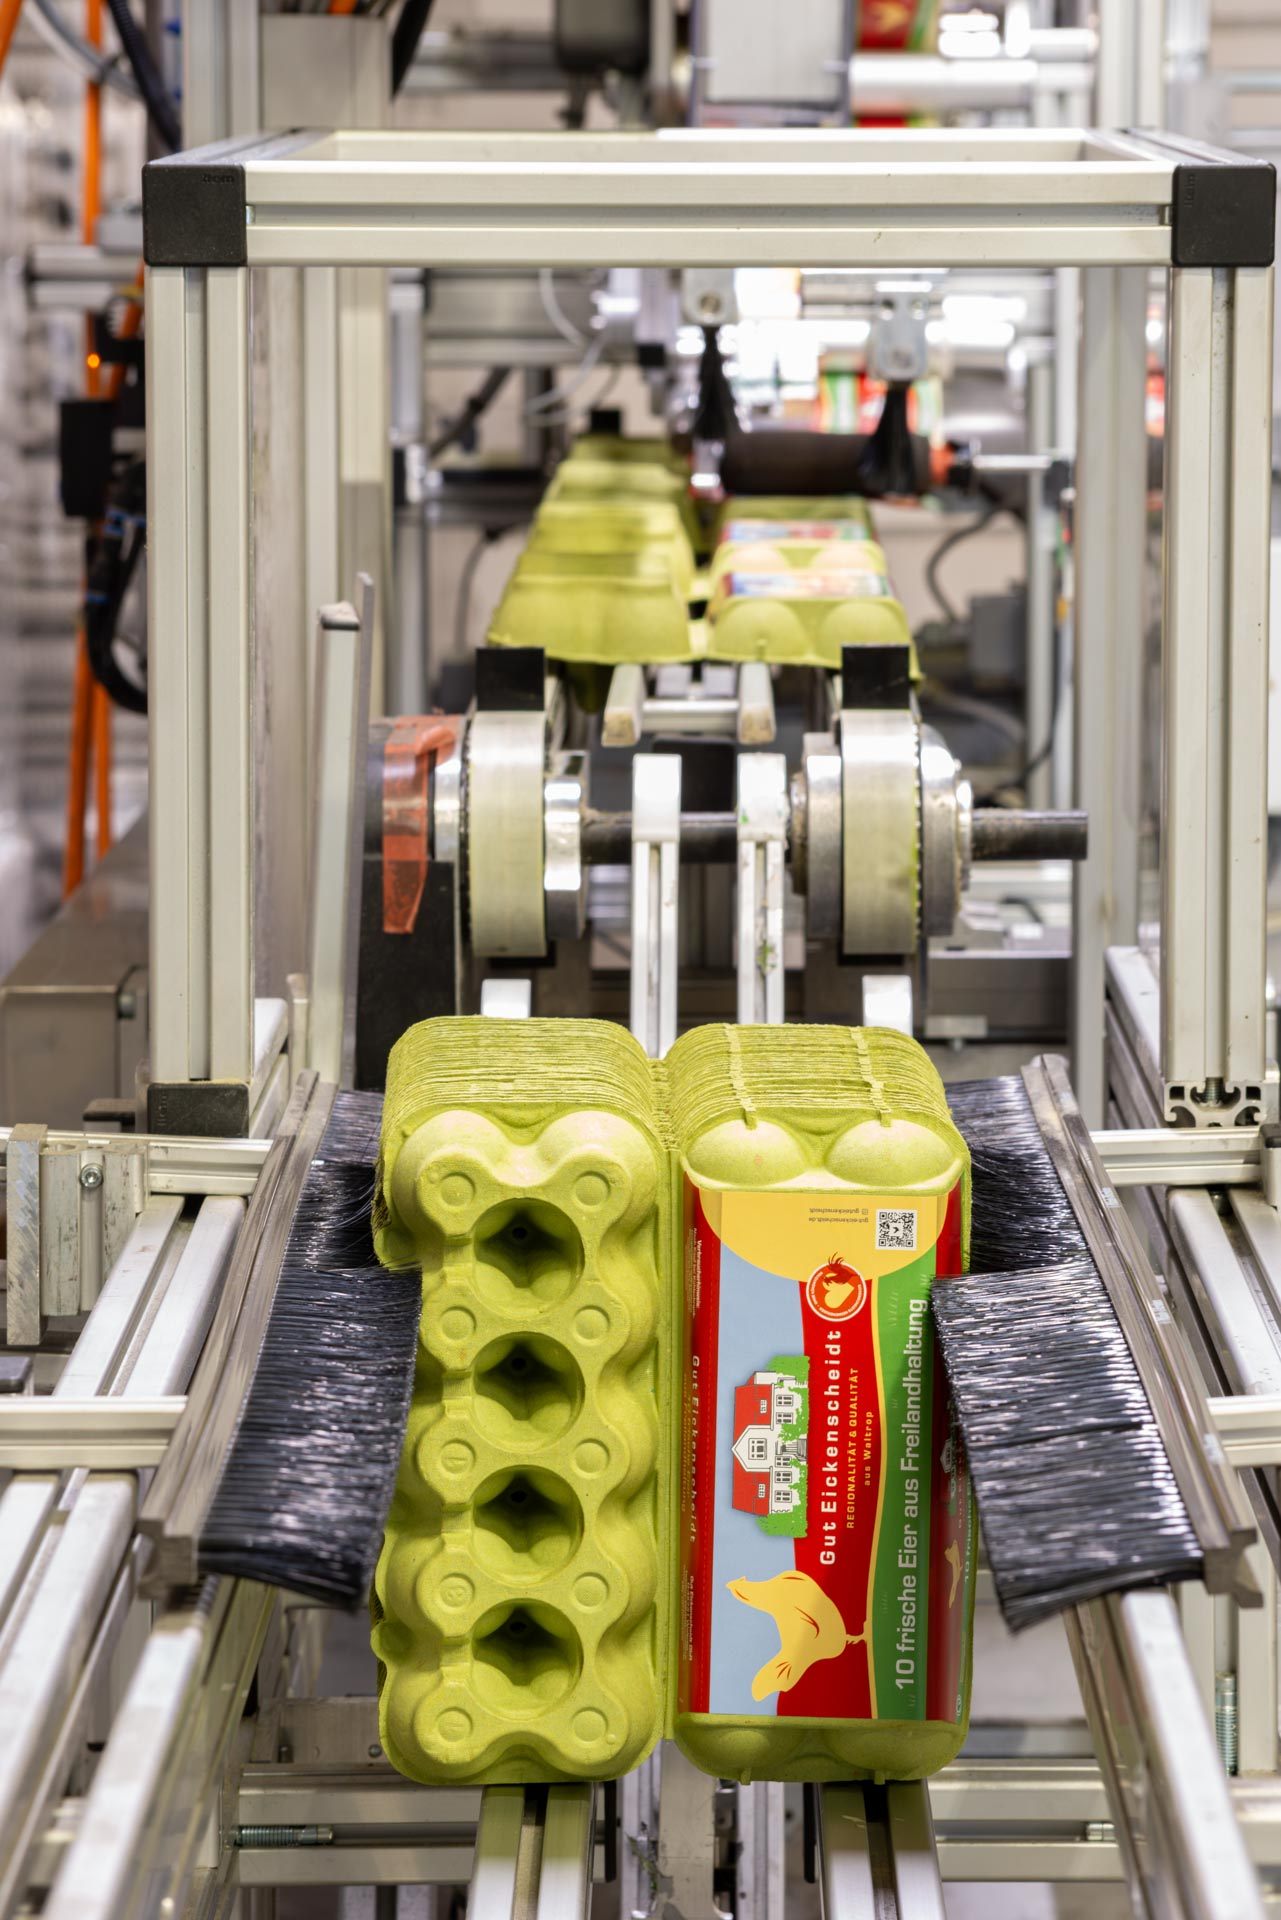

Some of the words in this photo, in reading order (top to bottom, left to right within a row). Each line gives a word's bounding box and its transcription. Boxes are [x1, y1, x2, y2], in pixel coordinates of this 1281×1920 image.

[692, 1355, 700, 1390] Gut
[848, 1368, 859, 1427] QUALITÄT
[900, 1298, 928, 1471] Freilandhaltung
[820, 1330, 841, 1513] Eickenscheidt
[848, 1430, 857, 1438] &
[863, 1411, 874, 1461] Waltrop
[689, 1396, 699, 1544] Eickenscheidt
[846, 1440, 857, 1529] REGIONALITÄT
[905, 1479, 918, 1518] aus
[819, 1521, 837, 1565] Gut
[898, 1524, 917, 1568] Eier
[896, 1588, 916, 1652] frische
[895, 1659, 915, 1689] 10
